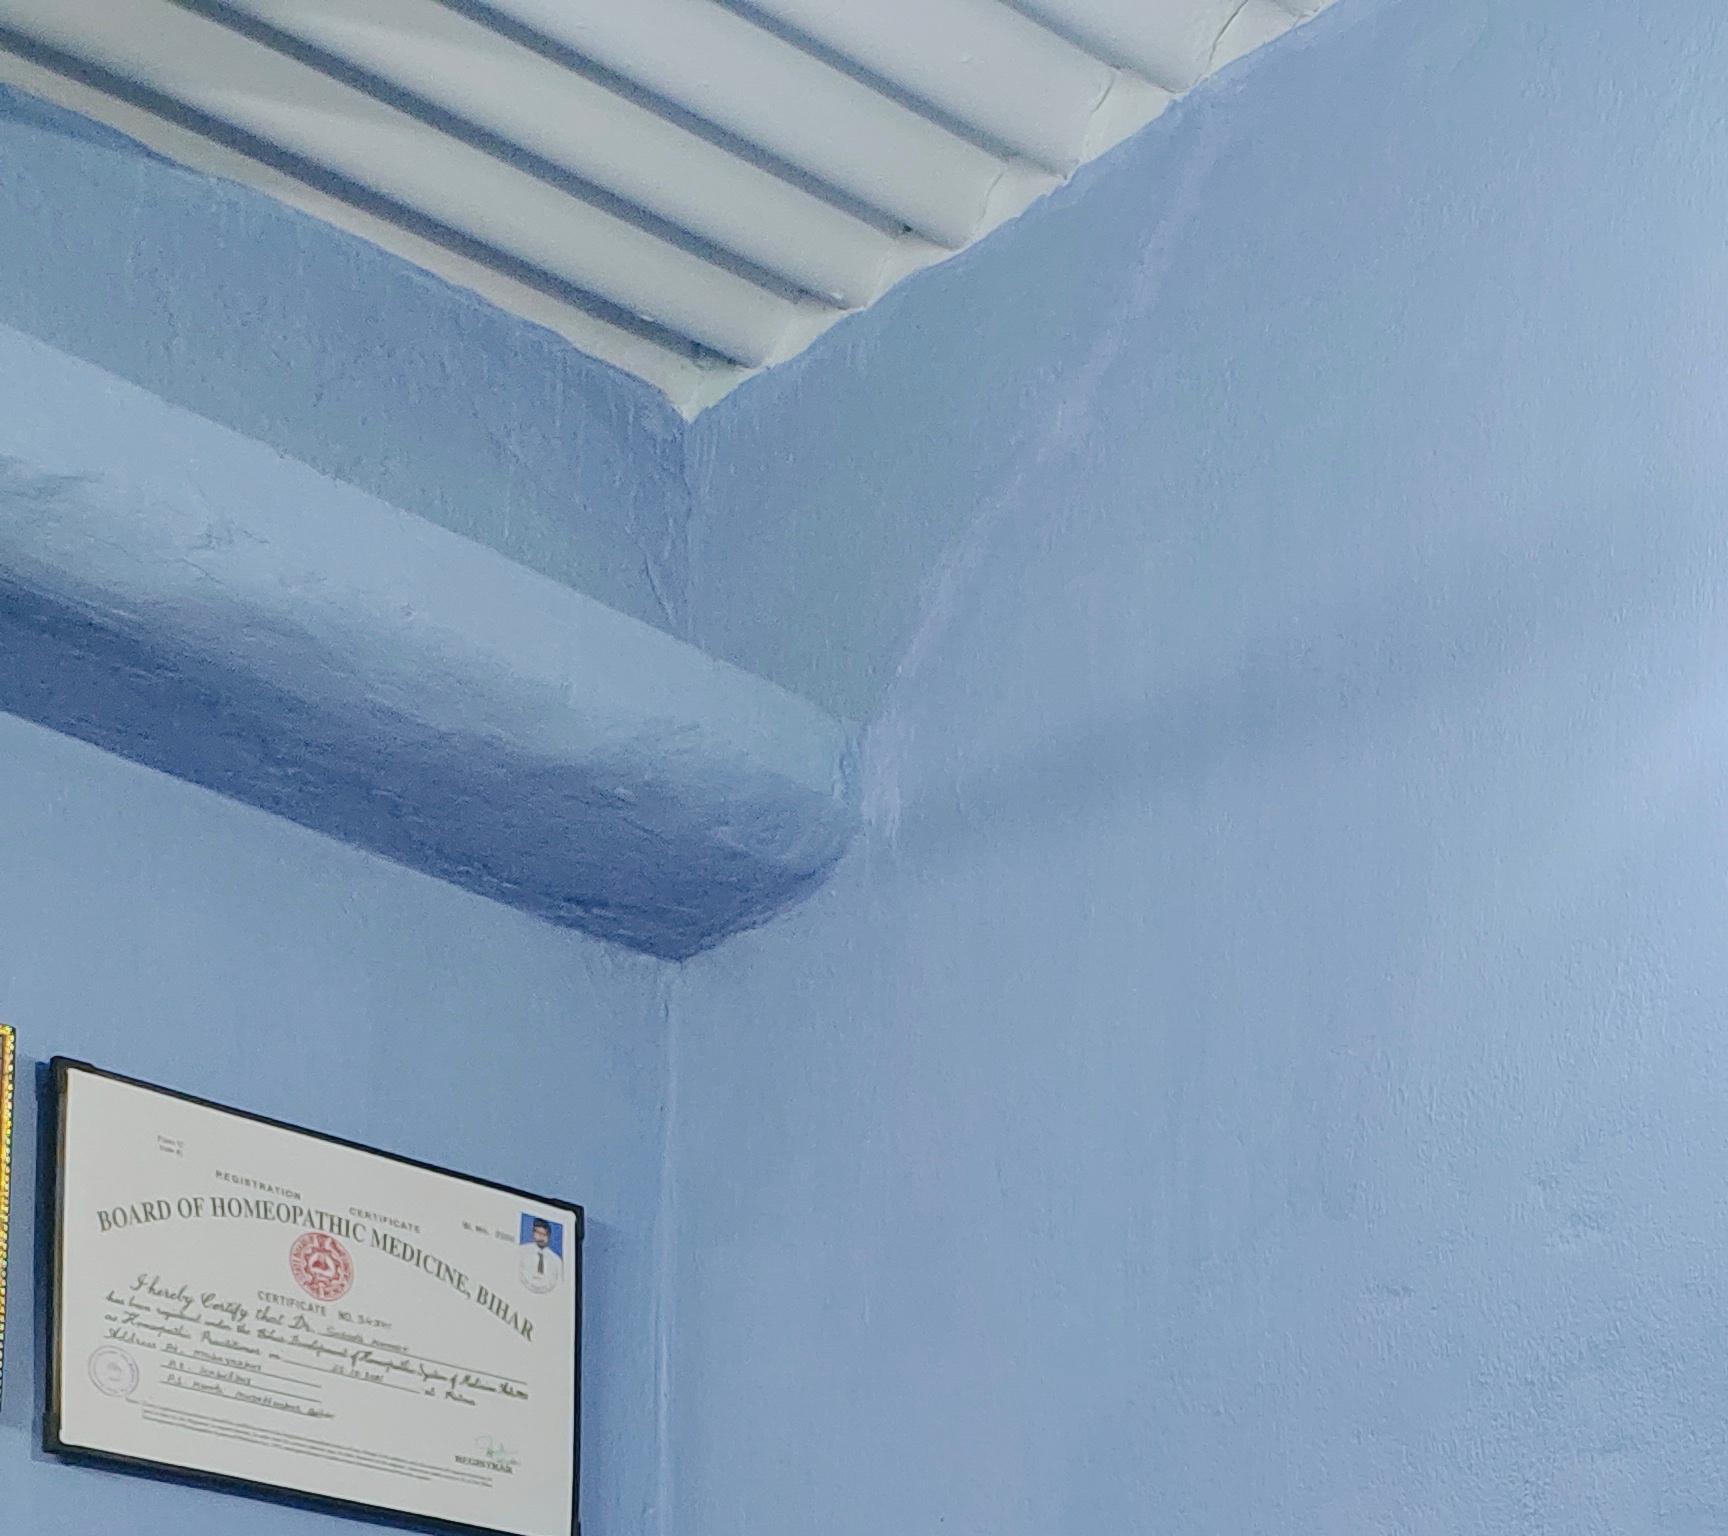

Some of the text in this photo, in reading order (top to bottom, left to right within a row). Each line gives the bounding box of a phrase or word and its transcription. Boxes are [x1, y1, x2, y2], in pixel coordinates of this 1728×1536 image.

[215, 1169, 421, 1233] REGISTRATION CERTIFICATE
[97, 1199, 172, 1232] BOARD
[177, 1197, 205, 1219] OF
[209, 1197, 367, 1243] HOMEOPATHIC
[371, 1228, 471, 1299] MEDICINE,
[476, 1285, 533, 1342] BIHAR
[149, 1275, 194, 1309] hereby
[256, 1306, 284, 1326] that
[257, 1290, 326, 1317] CERTIFICATE
